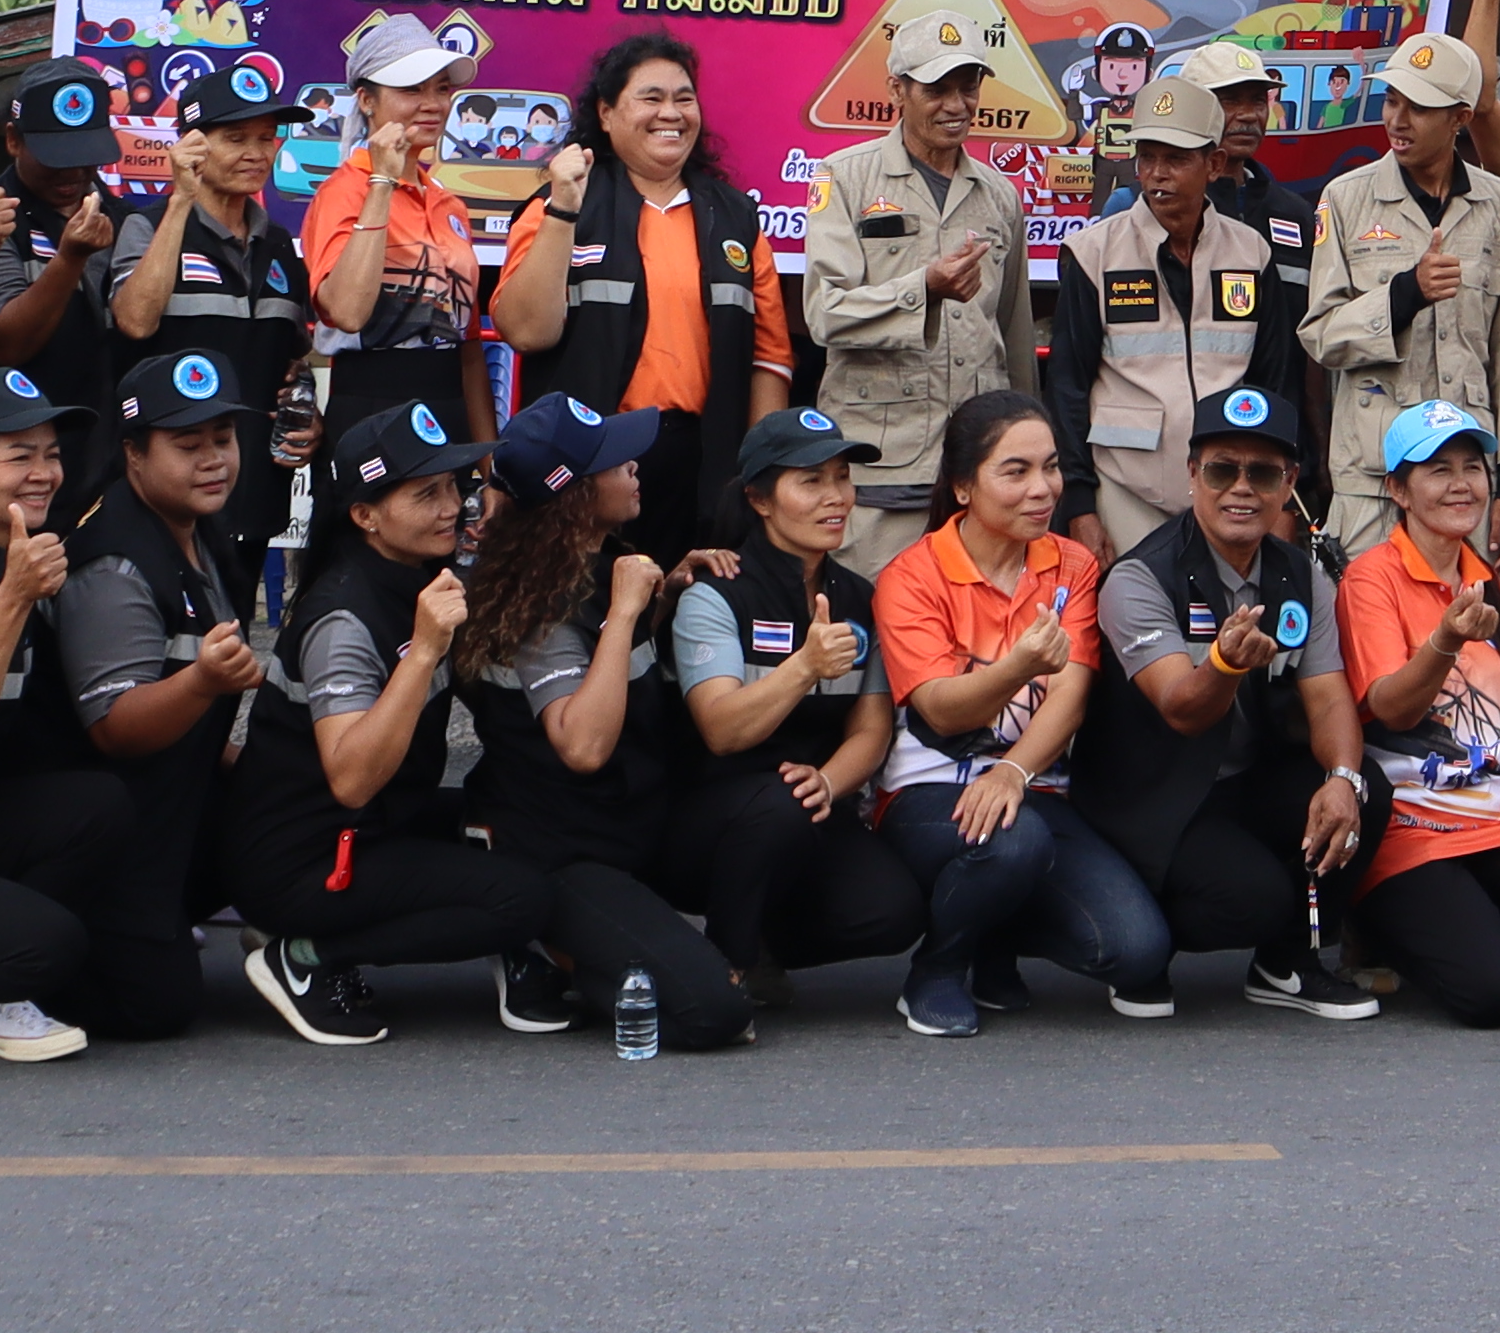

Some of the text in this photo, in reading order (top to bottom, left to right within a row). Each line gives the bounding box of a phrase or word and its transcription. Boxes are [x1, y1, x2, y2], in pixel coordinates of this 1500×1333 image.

[972, 107, 1030, 130] 567
[133, 138, 174, 151] CHOO
[124, 154, 167, 167] RIGHT
[996, 142, 1024, 168] STOP
[1061, 163, 1092, 172] CHOO
[1054, 175, 1086, 184] RIGHT
